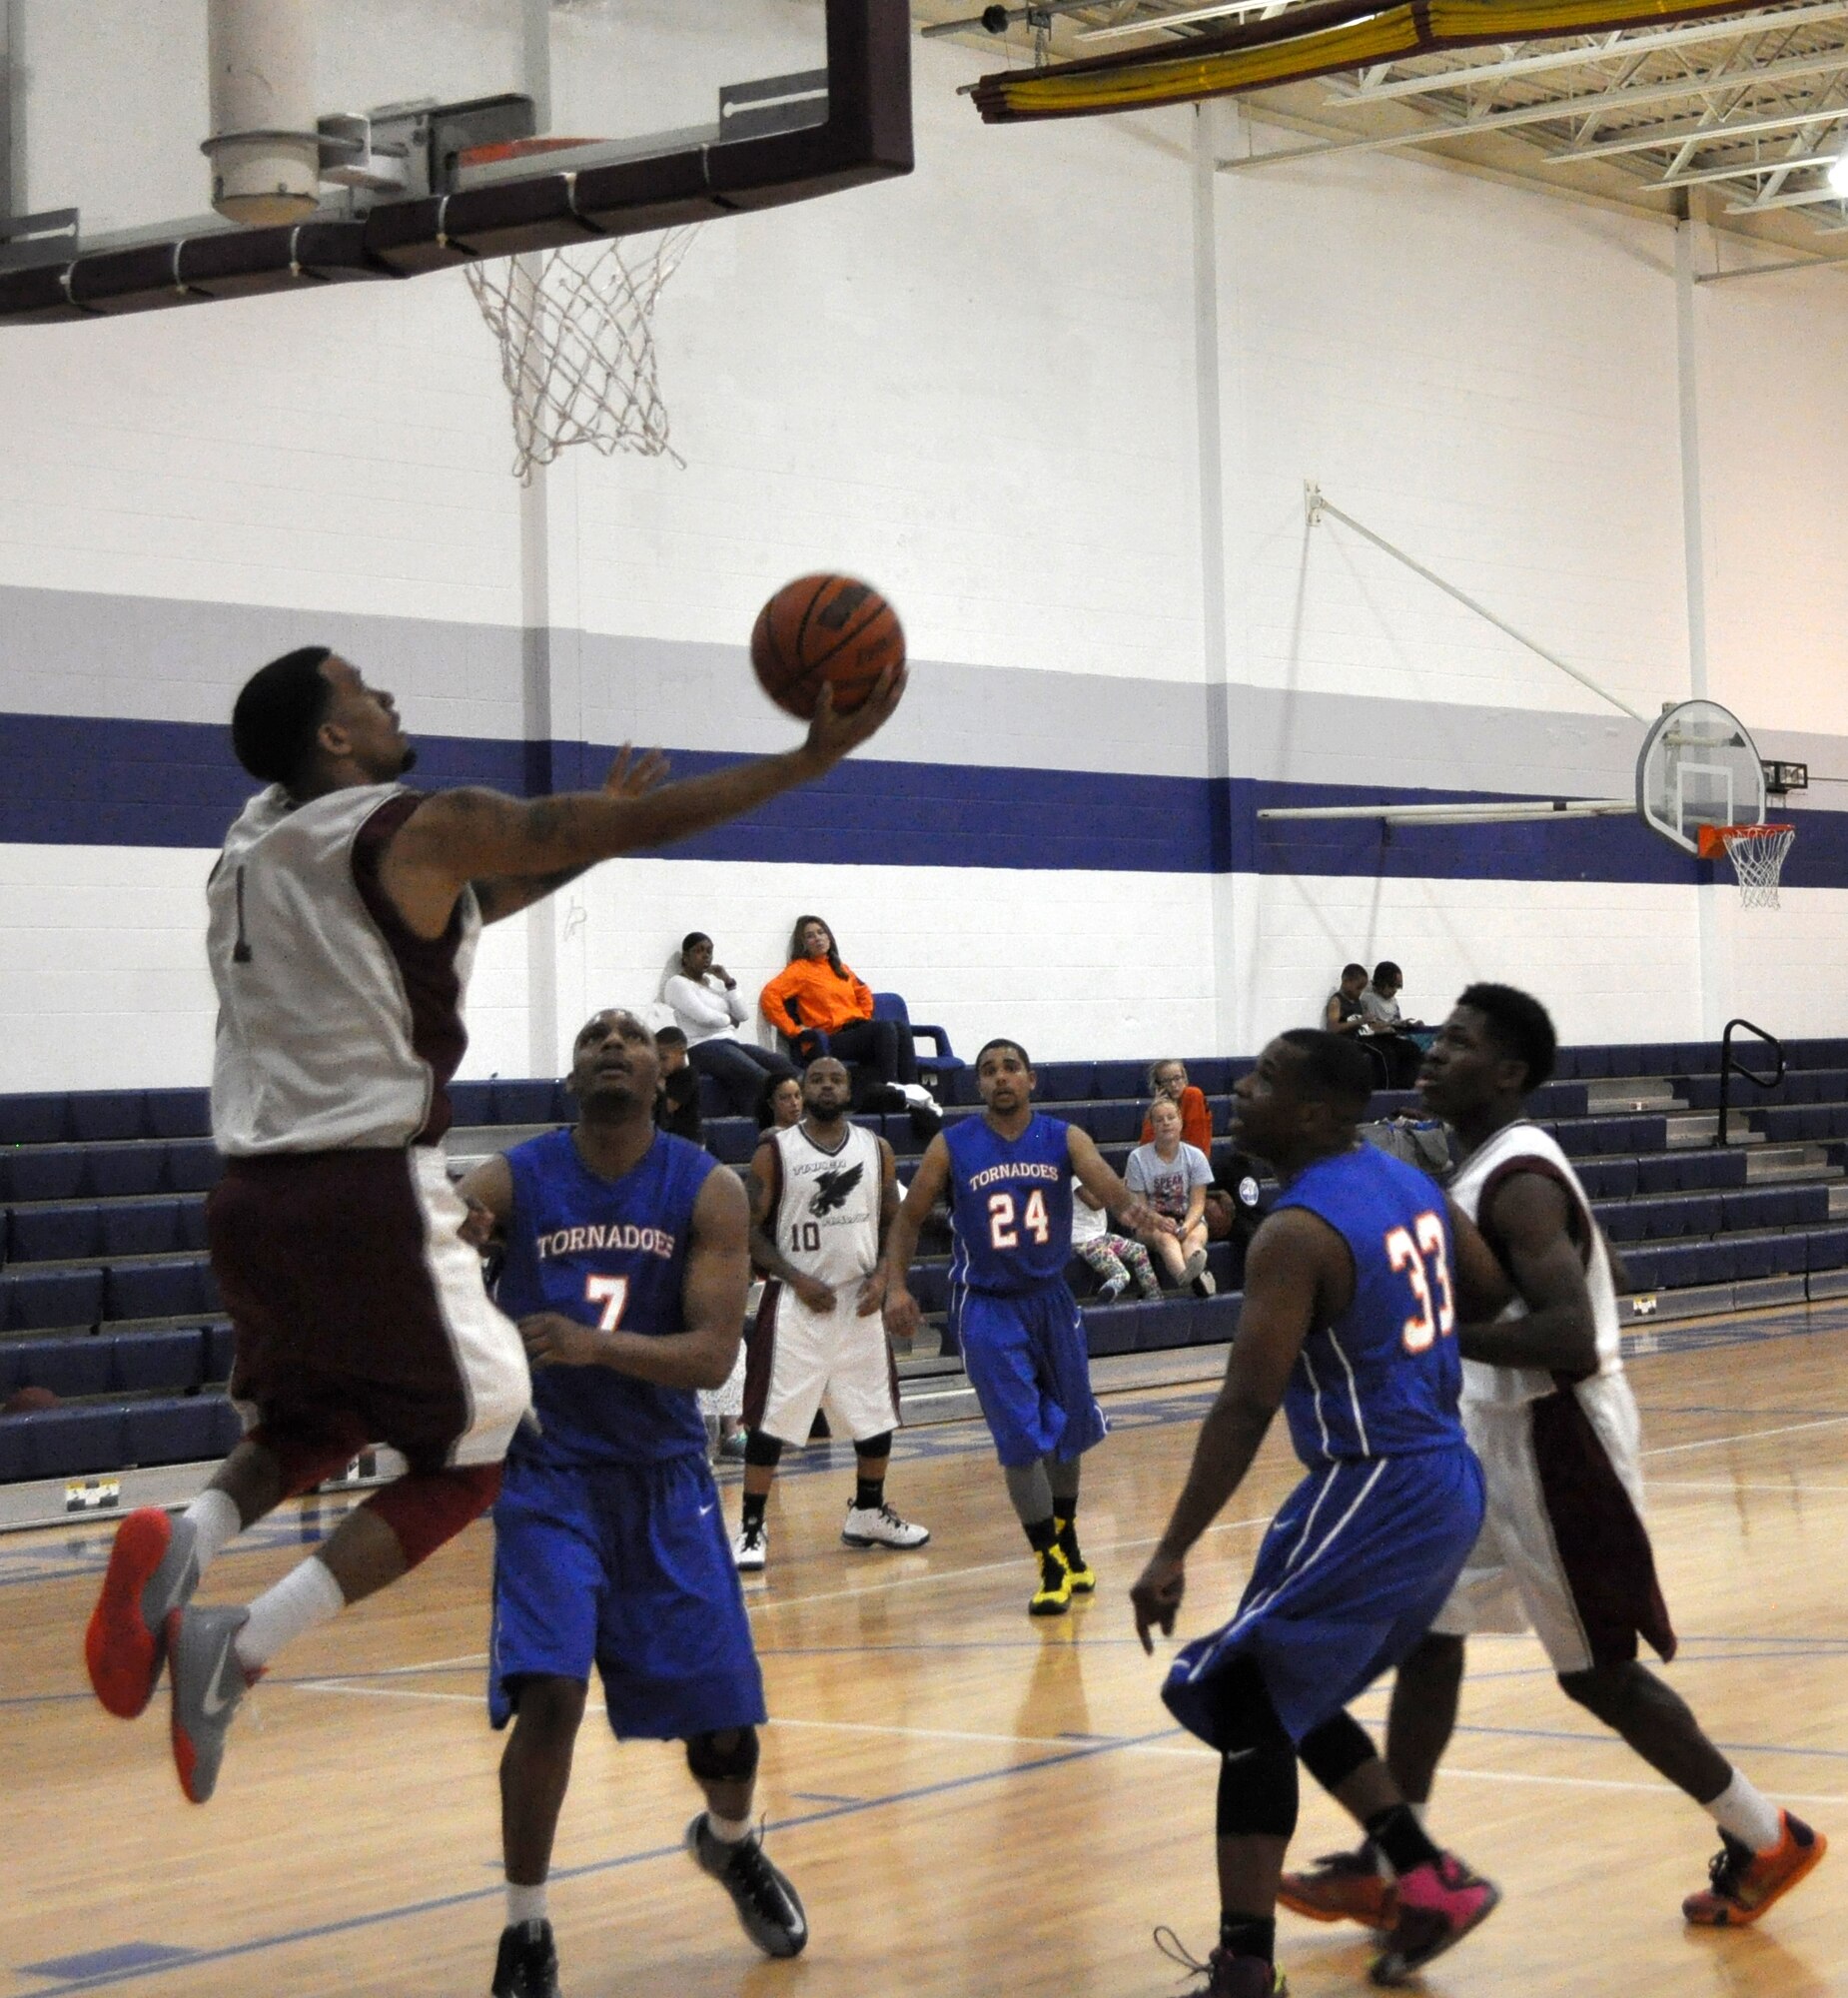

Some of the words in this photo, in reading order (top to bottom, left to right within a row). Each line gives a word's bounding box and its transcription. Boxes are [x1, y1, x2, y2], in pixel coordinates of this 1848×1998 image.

[969, 1162, 1059, 1192] TORNADOES
[536, 1224, 676, 1259] TORNADOES
[791, 1222, 821, 1252] 10
[987, 1189, 1050, 1250] 24
[585, 1273, 629, 1333] 7
[1385, 1210, 1455, 1355] 33
